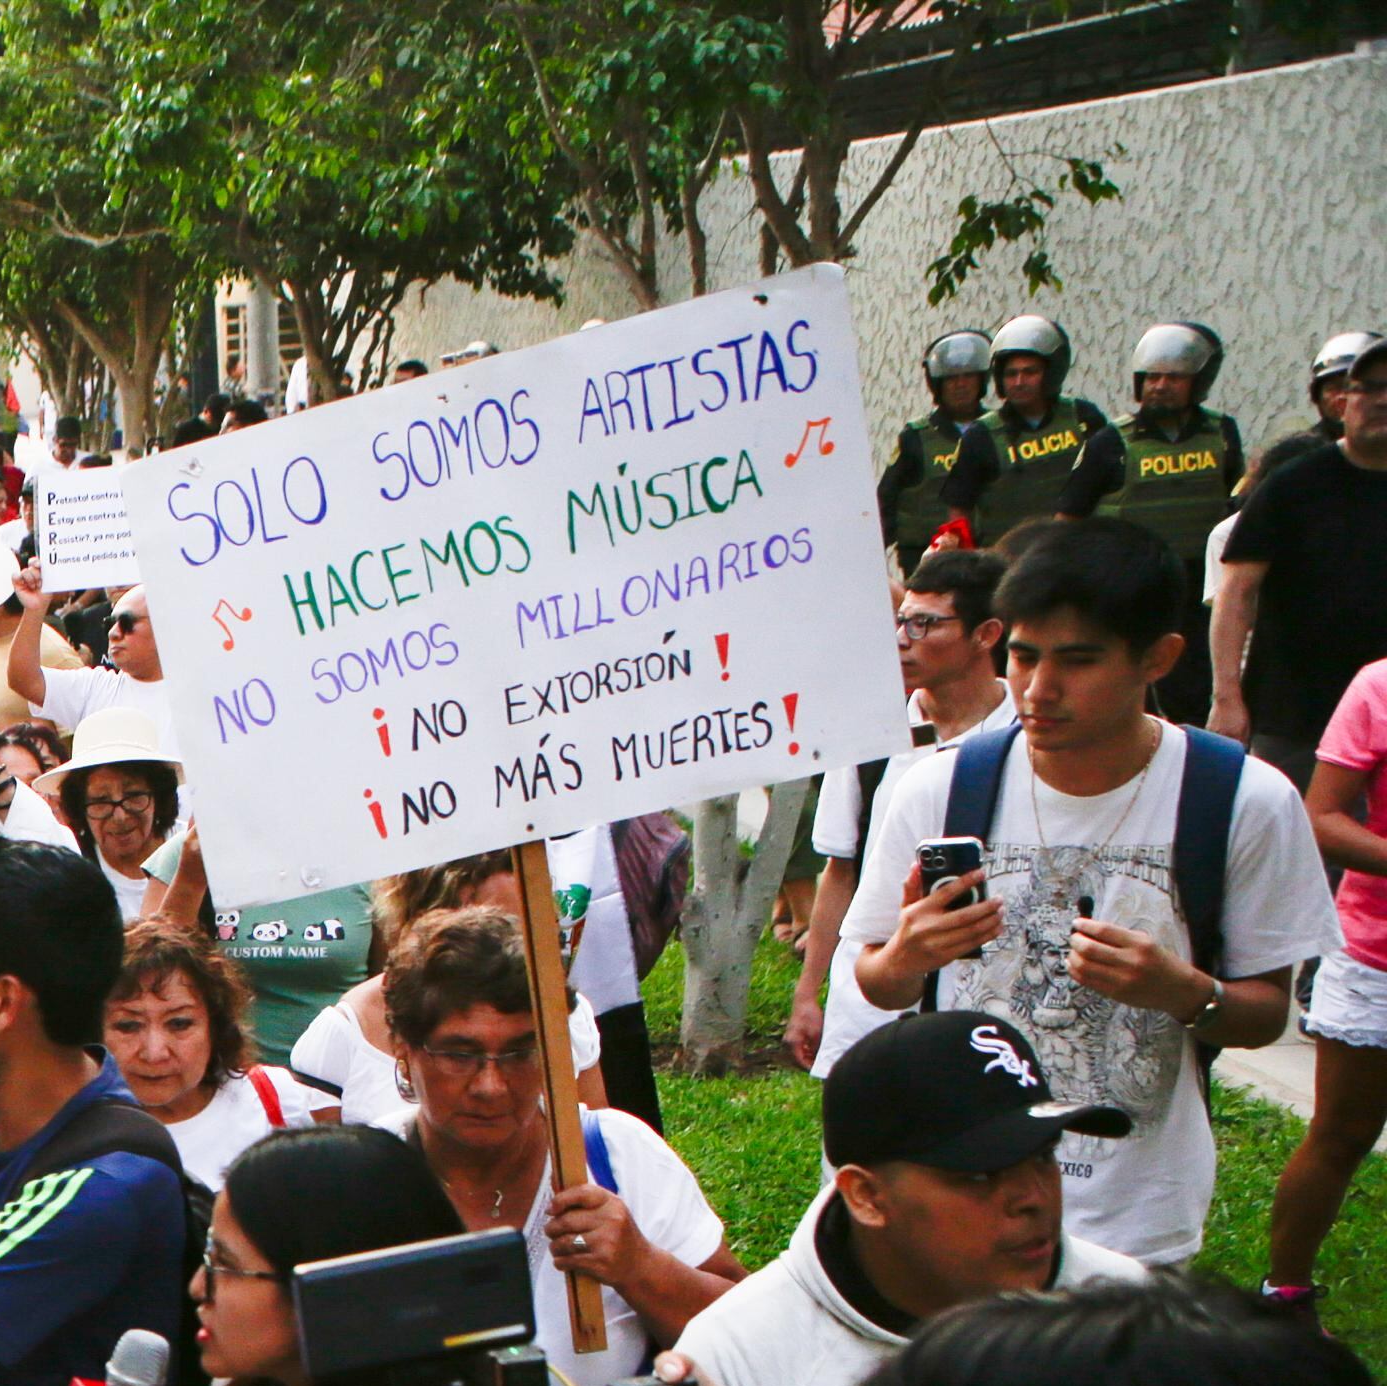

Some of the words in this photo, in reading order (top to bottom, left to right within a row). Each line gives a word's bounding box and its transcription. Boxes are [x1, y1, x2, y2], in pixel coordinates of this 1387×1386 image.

[167, 456, 328, 567] SOLO
[372, 388, 541, 502] SOMOS
[577, 319, 819, 445] ARTISTAS
[1140, 450, 1217, 477] POLICIA
[283, 515, 532, 637] HACEMOS
[565, 449, 764, 554] MÚSICA
[213, 677, 276, 744] NO
[310, 623, 460, 705] SOMOS
[515, 527, 814, 649] MILLONARIOS
[494, 733, 583, 808] MÁS
[224, 947, 283, 958] CUSTOM
[287, 946, 329, 958] NAME
[1058, 1160, 1094, 1179] XICO
